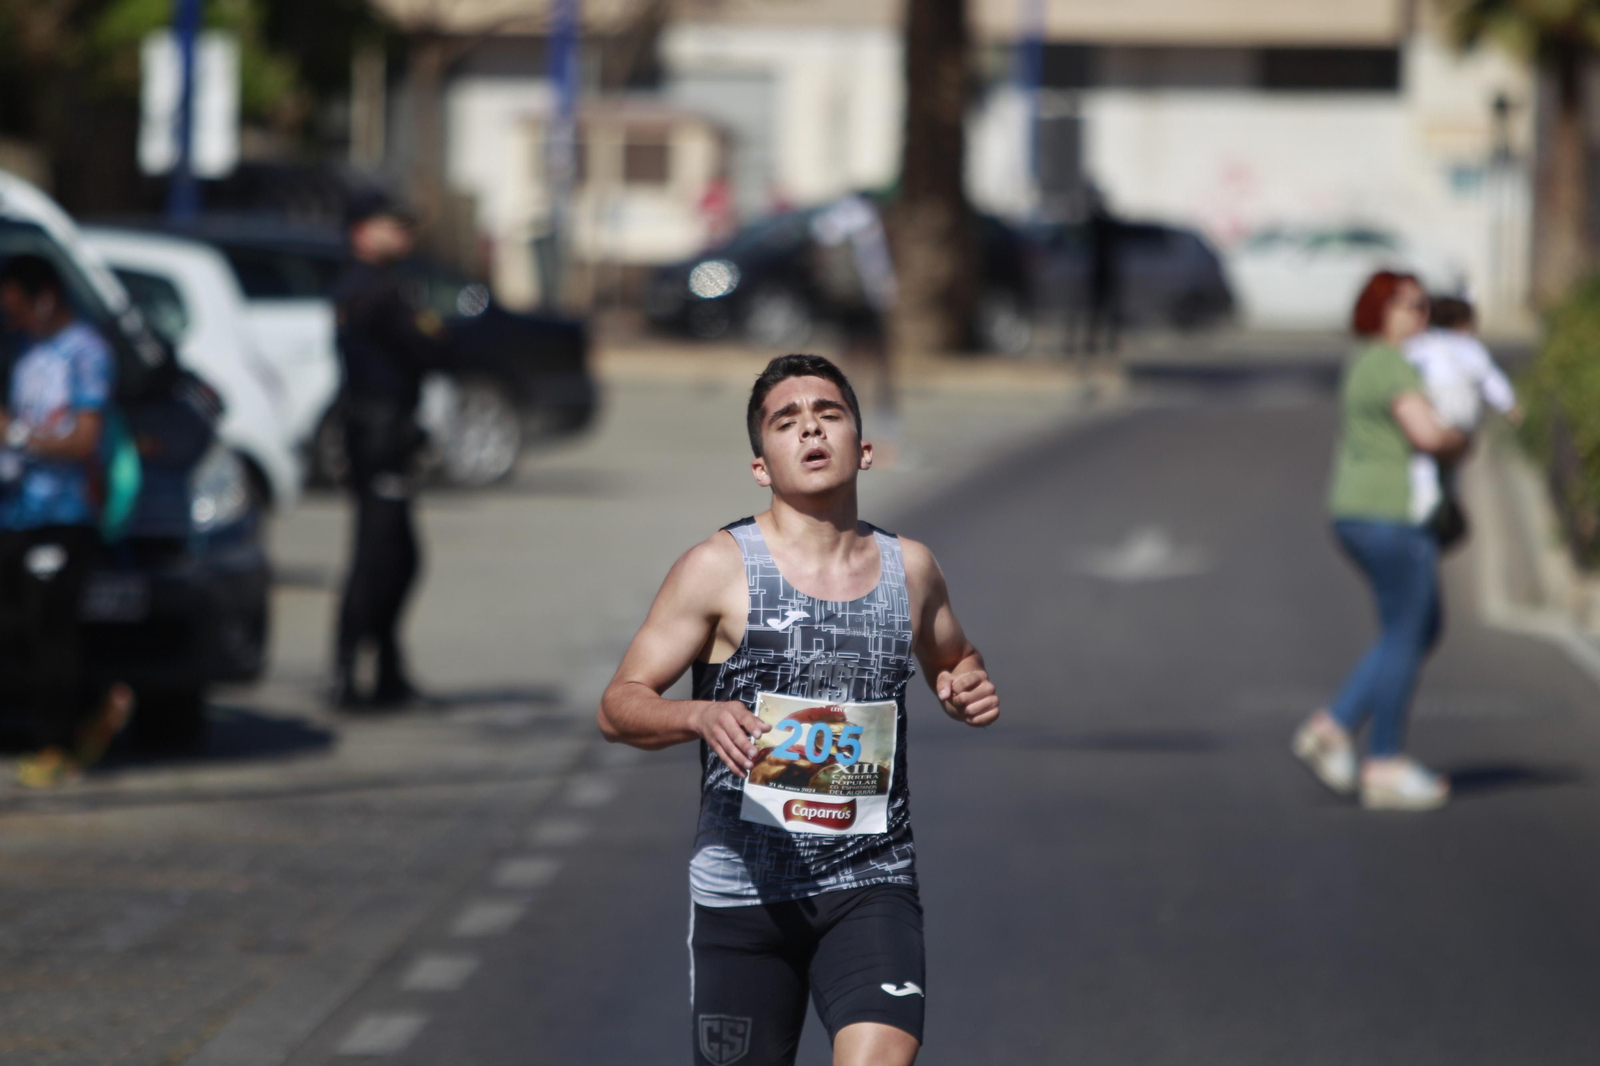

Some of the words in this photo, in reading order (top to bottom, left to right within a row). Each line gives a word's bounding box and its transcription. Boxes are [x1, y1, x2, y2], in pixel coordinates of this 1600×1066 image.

[771, 718, 863, 765] 205
[832, 763, 879, 774] XIII
[702, 1020, 745, 1062] CS
